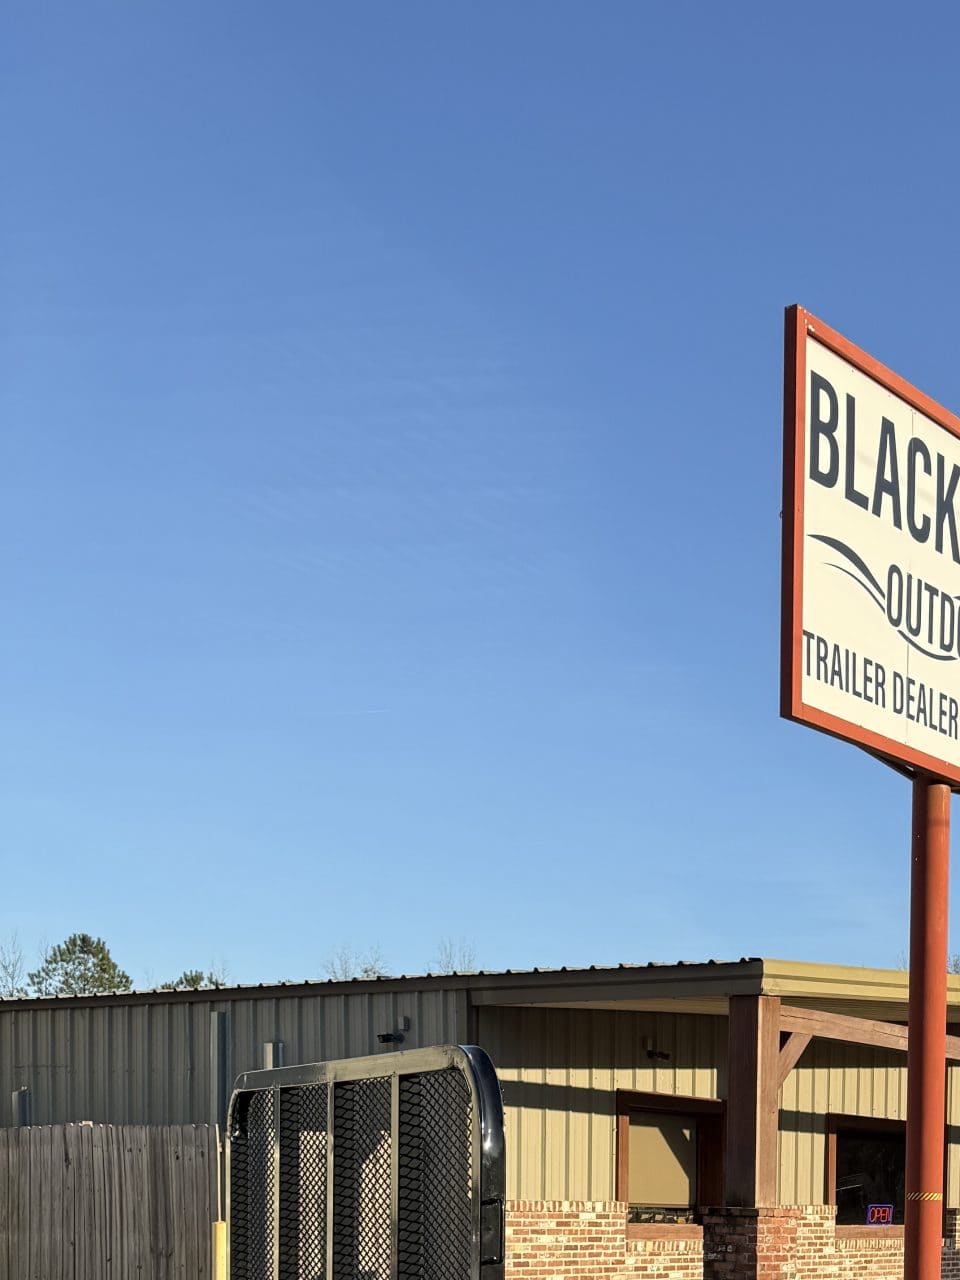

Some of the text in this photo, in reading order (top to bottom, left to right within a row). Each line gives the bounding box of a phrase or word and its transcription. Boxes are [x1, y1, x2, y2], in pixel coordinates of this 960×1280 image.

[802, 629, 887, 709] TRAILER
[892, 670, 959, 742] DEALER
[869, 1207, 892, 1223] OPEN
